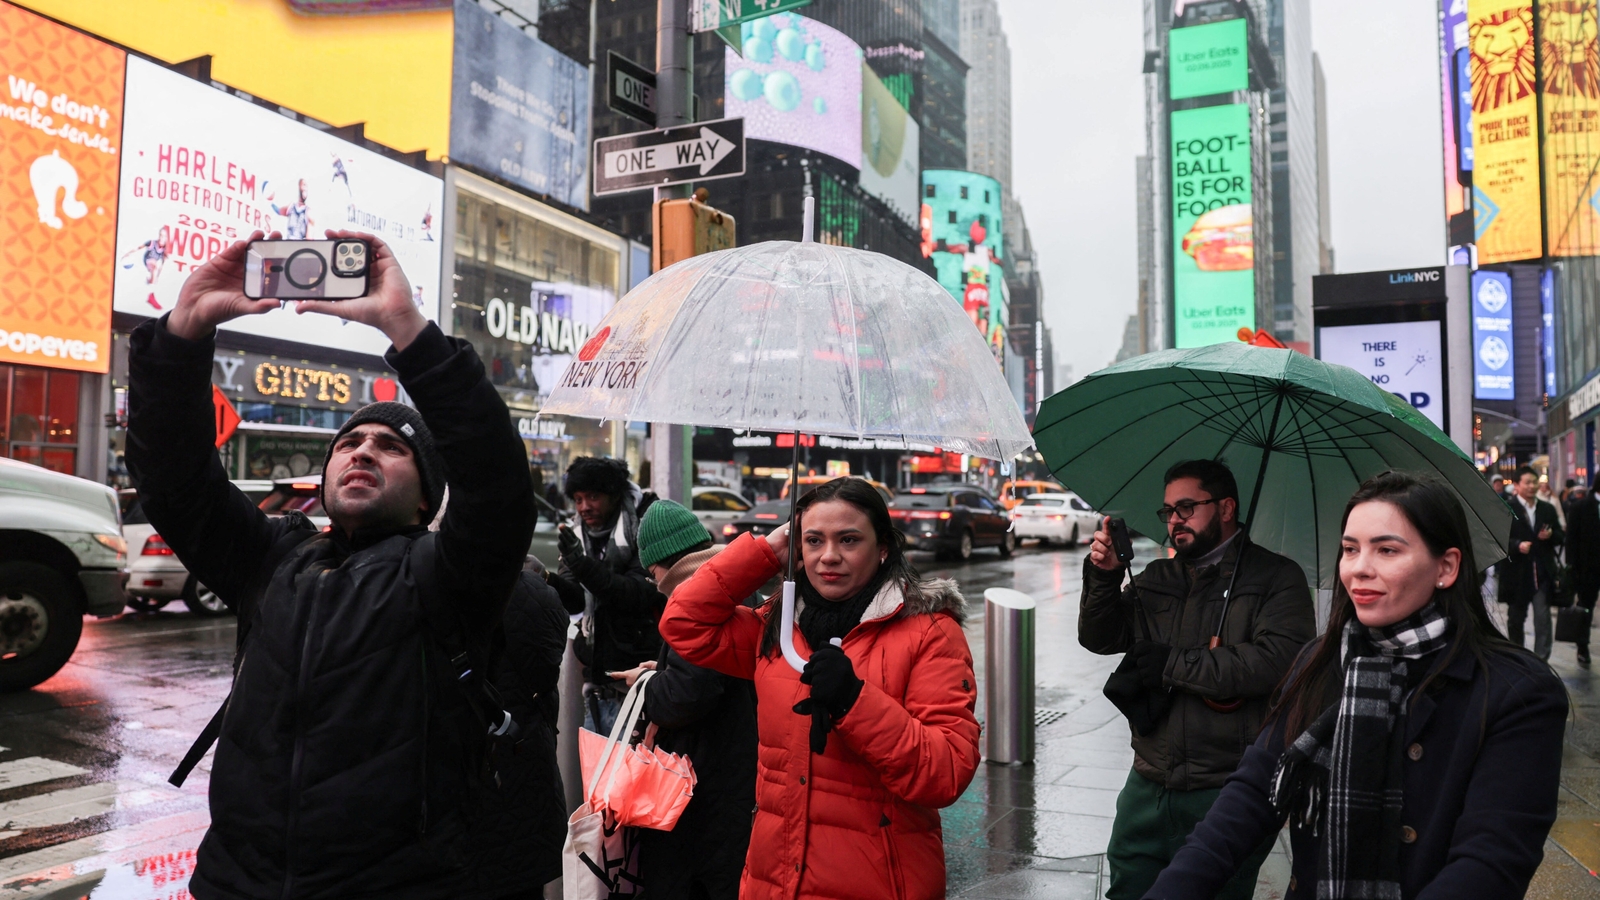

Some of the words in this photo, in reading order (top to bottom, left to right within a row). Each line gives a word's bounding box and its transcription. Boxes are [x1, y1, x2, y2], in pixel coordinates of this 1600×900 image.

[1177, 52, 1207, 63] Uber
[1208, 45, 1240, 58] Eats
[8, 74, 48, 108] We
[51, 93, 110, 129] don't
[623, 77, 650, 108] ONE
[0, 103, 58, 136] make
[58, 123, 117, 155] sense.
[1488, 127, 1530, 143] CALLING
[616, 149, 656, 174] ONE
[676, 139, 720, 165] WAY
[1176, 135, 1247, 157] FOOT-
[157, 143, 256, 201] HARLEM
[500, 158, 521, 177] OLD
[1177, 157, 1231, 177] BALL
[1177, 181, 1195, 198] IS
[1201, 176, 1246, 195] FOR
[133, 176, 272, 234] GLOBETROTTERS
[178, 213, 238, 239] 2025
[164, 224, 229, 262] WOR
[1389, 270, 1440, 285] LinkNYC
[1183, 308, 1213, 319] Uber
[1215, 305, 1246, 318] Eats
[486, 297, 539, 345] OLD
[541, 311, 591, 354] NAV
[1362, 341, 1398, 352] THERE
[1375, 357, 1386, 367] IS
[255, 361, 352, 405] GIFTS
[561, 361, 604, 388] NEW
[601, 361, 648, 389] YORK
[1371, 374, 1390, 385] NO
[518, 417, 539, 436] OLD
[539, 420, 567, 438] NAVY
